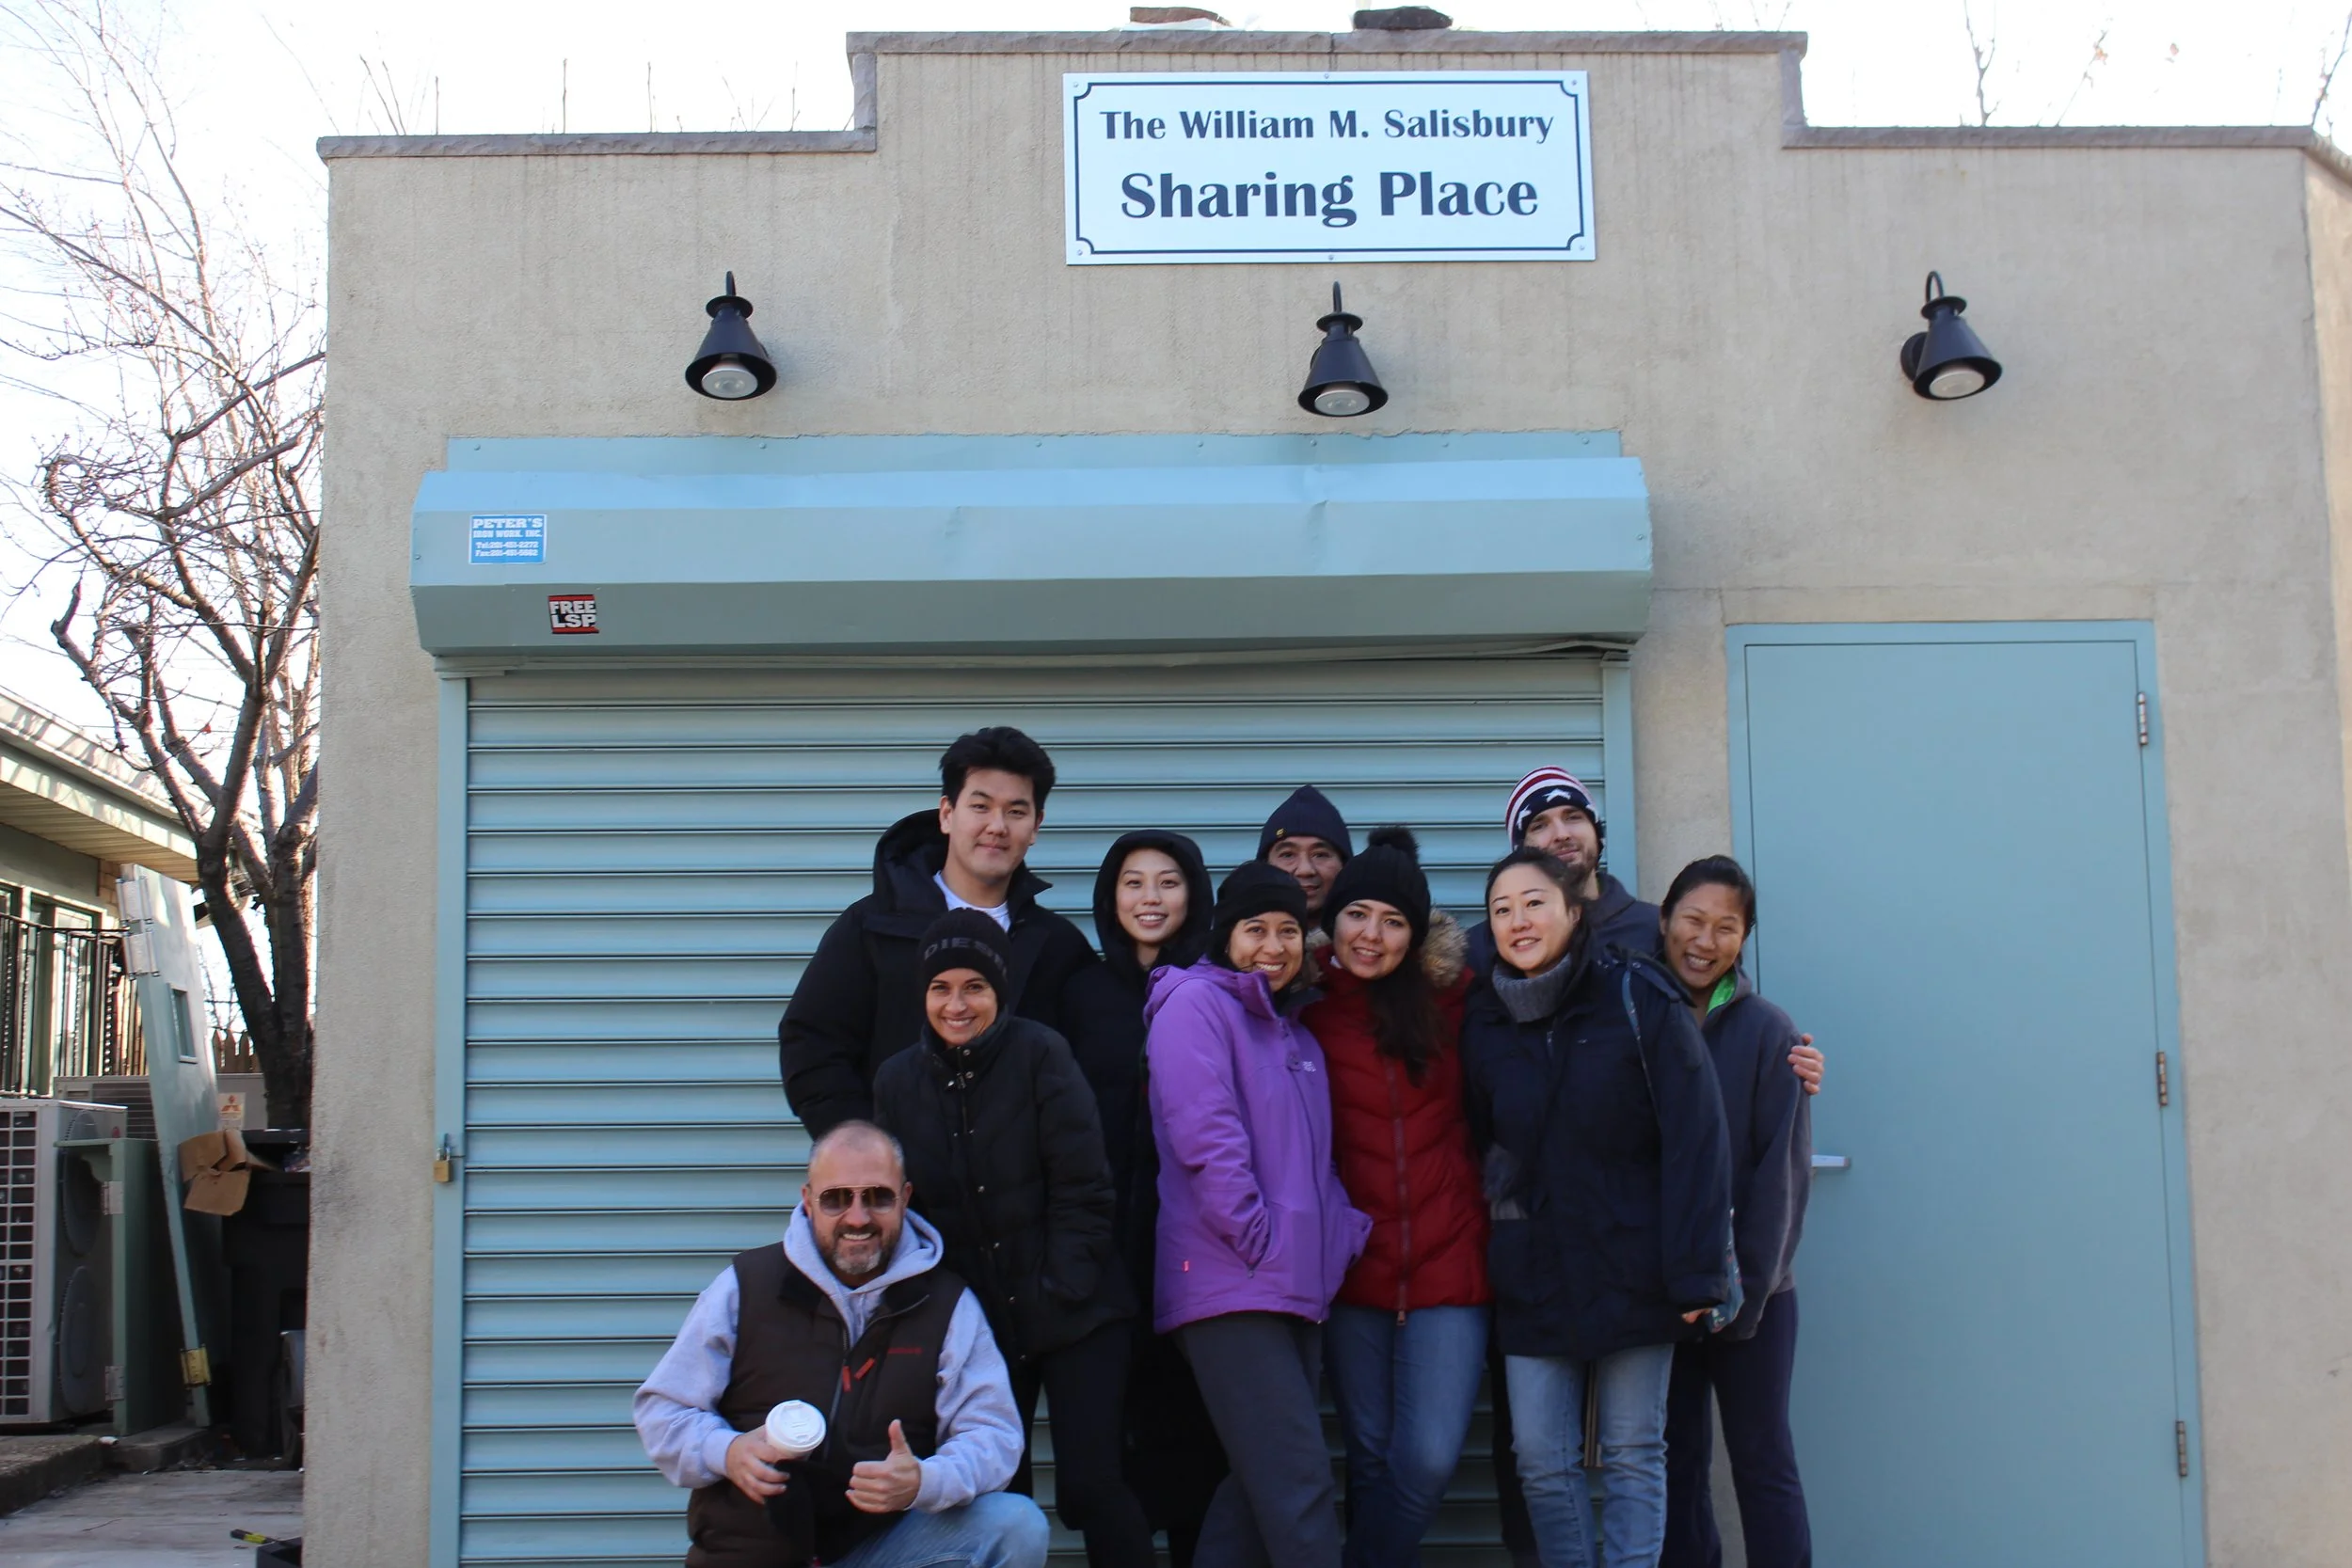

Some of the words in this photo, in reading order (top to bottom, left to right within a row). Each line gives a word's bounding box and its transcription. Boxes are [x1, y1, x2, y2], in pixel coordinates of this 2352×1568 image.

[1099, 110, 1167, 140] The
[1179, 109, 1315, 139] William
[1329, 109, 1370, 138] M.
[1384, 108, 1555, 145] Salisbury
[1120, 171, 1358, 229] Sharing
[1379, 170, 1539, 217] Place
[472, 517, 543, 529] PETER'S
[473, 530, 494, 538] IRON
[548, 600, 596, 614] FREE
[550, 614, 596, 628] LSP
